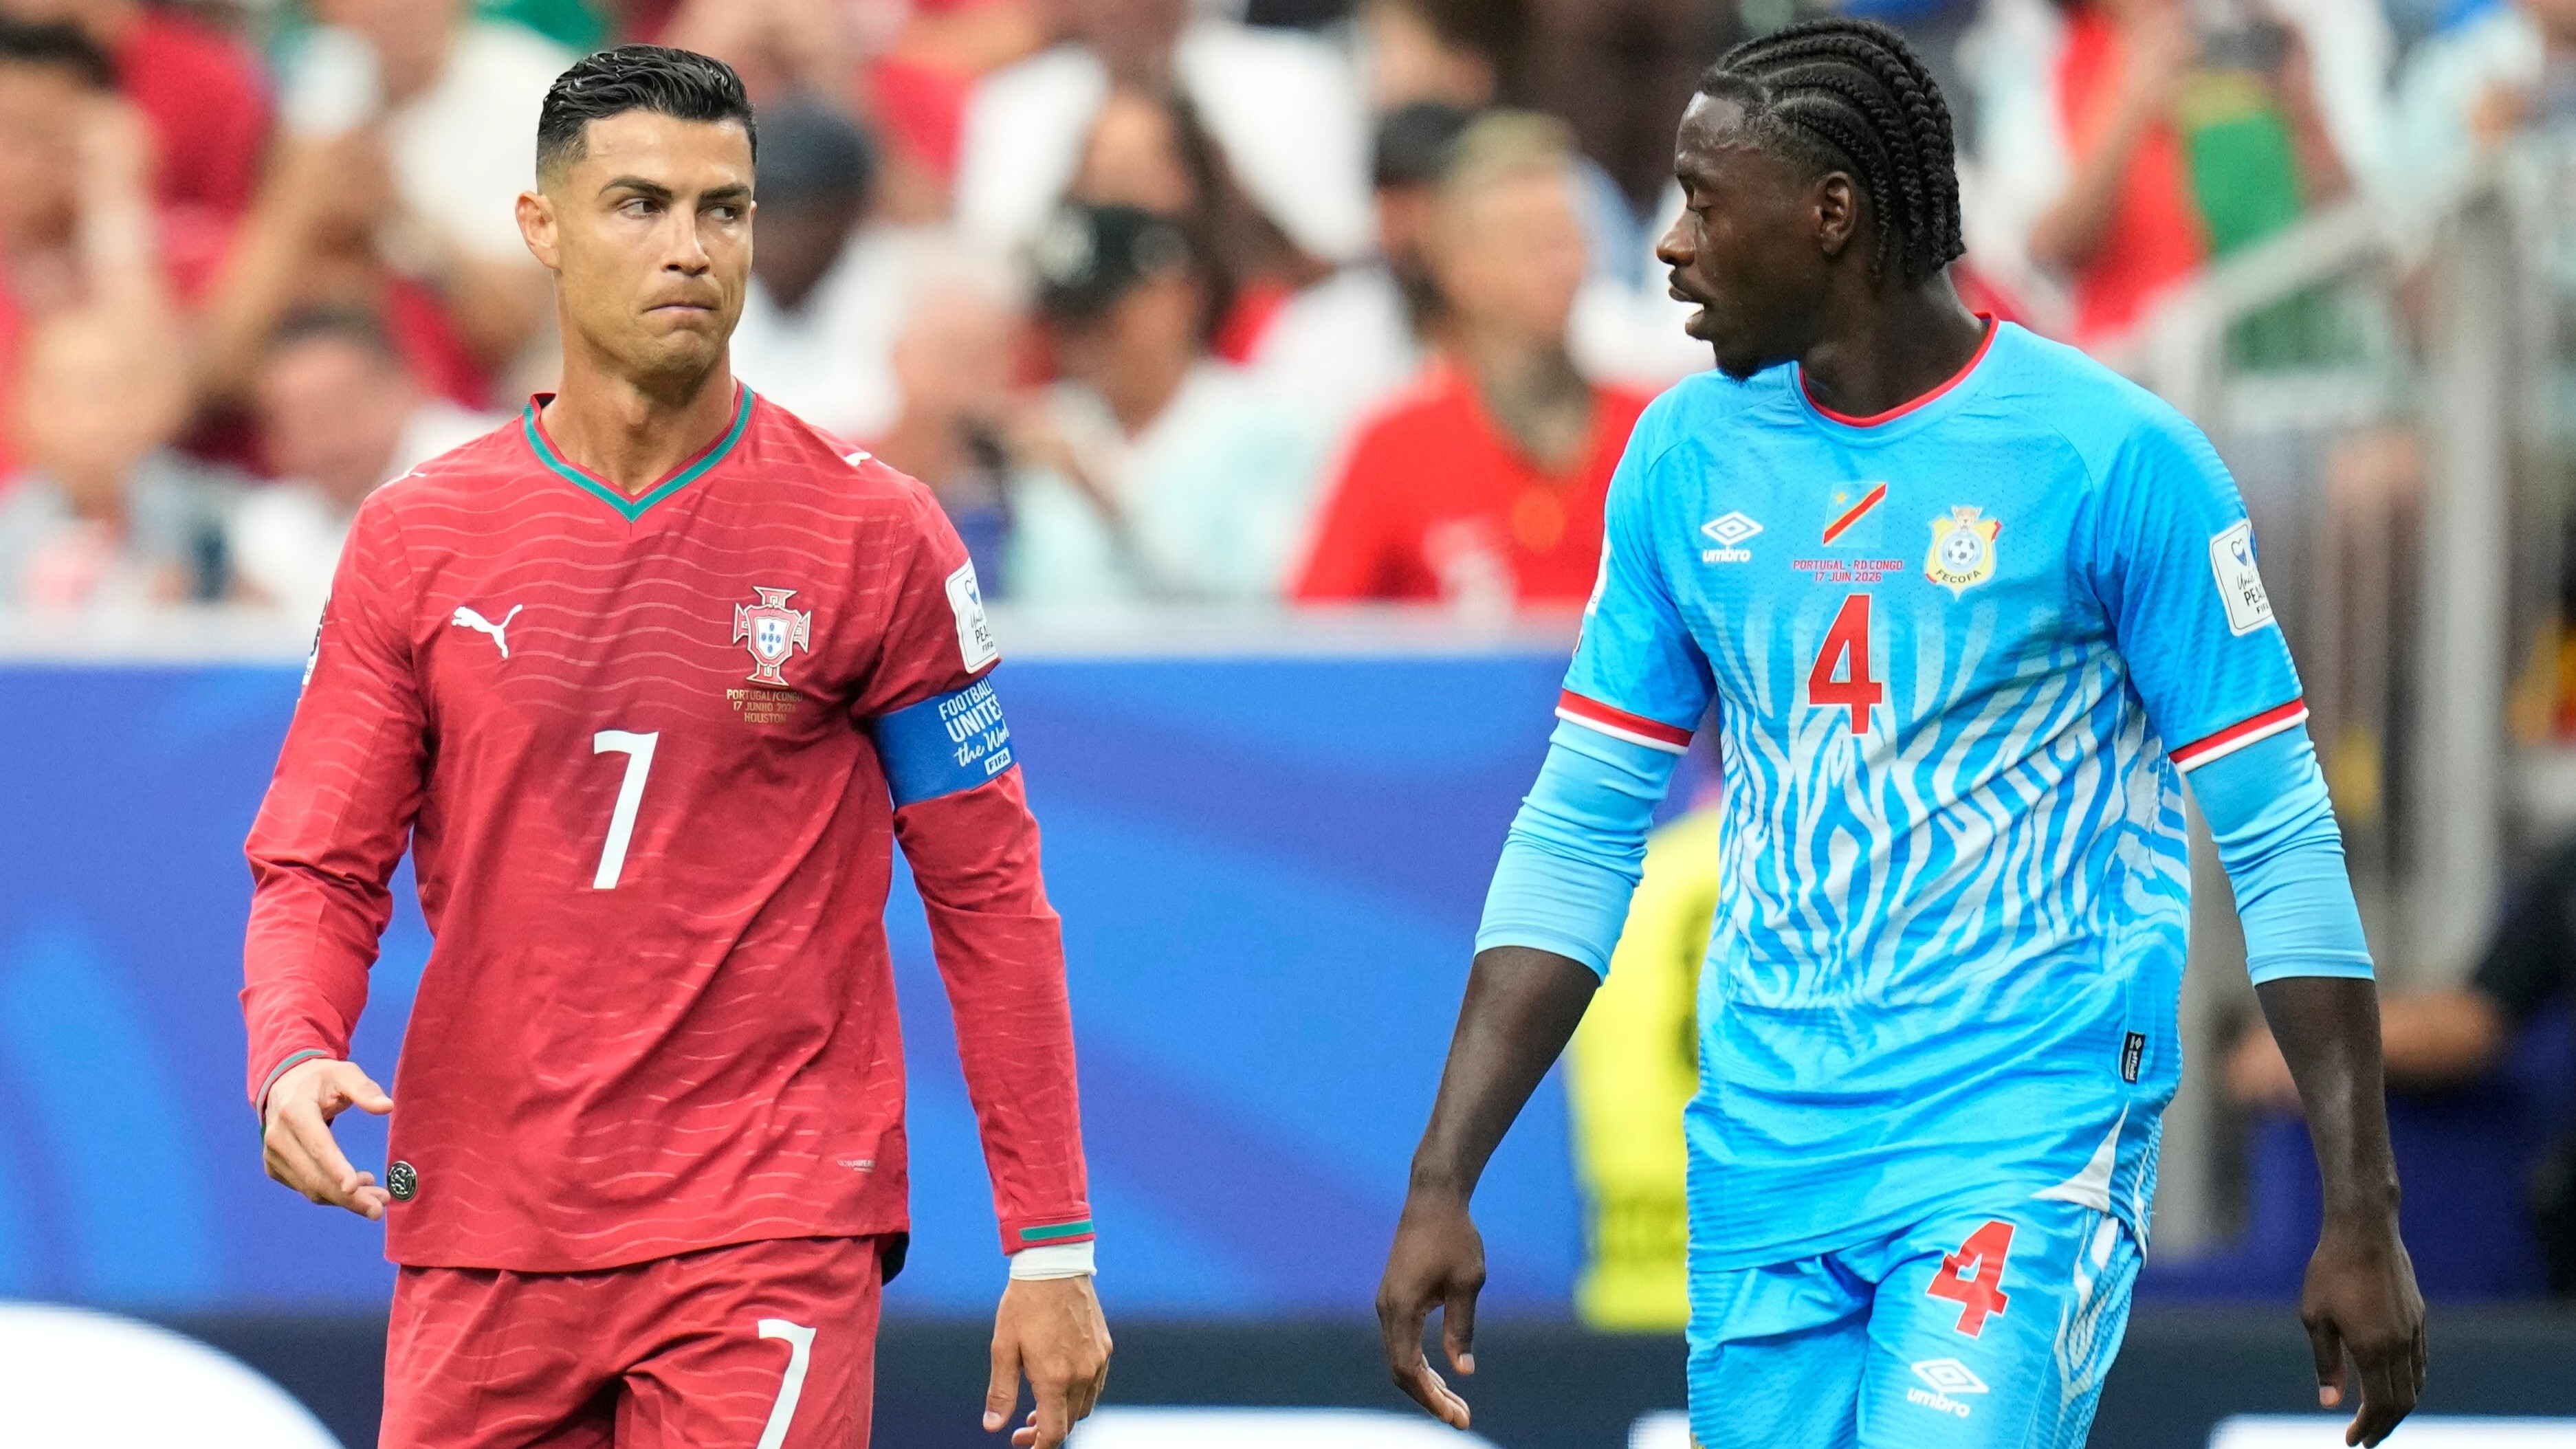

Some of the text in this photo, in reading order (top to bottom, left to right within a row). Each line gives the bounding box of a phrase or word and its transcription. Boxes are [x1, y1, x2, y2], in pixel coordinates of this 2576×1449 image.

[1703, 546, 1751, 562] umbro
[1793, 560, 1845, 571] PORTUGAL
[1853, 560, 1867, 570] RD
[1869, 560, 1904, 571] CONGO
[1814, 571, 1882, 582] 17 JUIN 2026
[1936, 568, 1981, 584] FECOFA
[2244, 584, 2266, 606] PEAC
[1807, 593, 1883, 735] 4
[734, 701, 742, 711] 17
[746, 702, 773, 712] JUNHO
[938, 677, 993, 720] FOOTBALL
[744, 712, 787, 723] HOUSTON
[945, 694, 1003, 742] UNITES
[953, 741, 984, 766] the
[988, 753, 1009, 771] FIFA
[593, 730, 659, 889] 7
[1926, 1220, 2016, 1338] 4
[757, 1318, 817, 1449] 7
[1906, 1386, 1971, 1417] umbro
